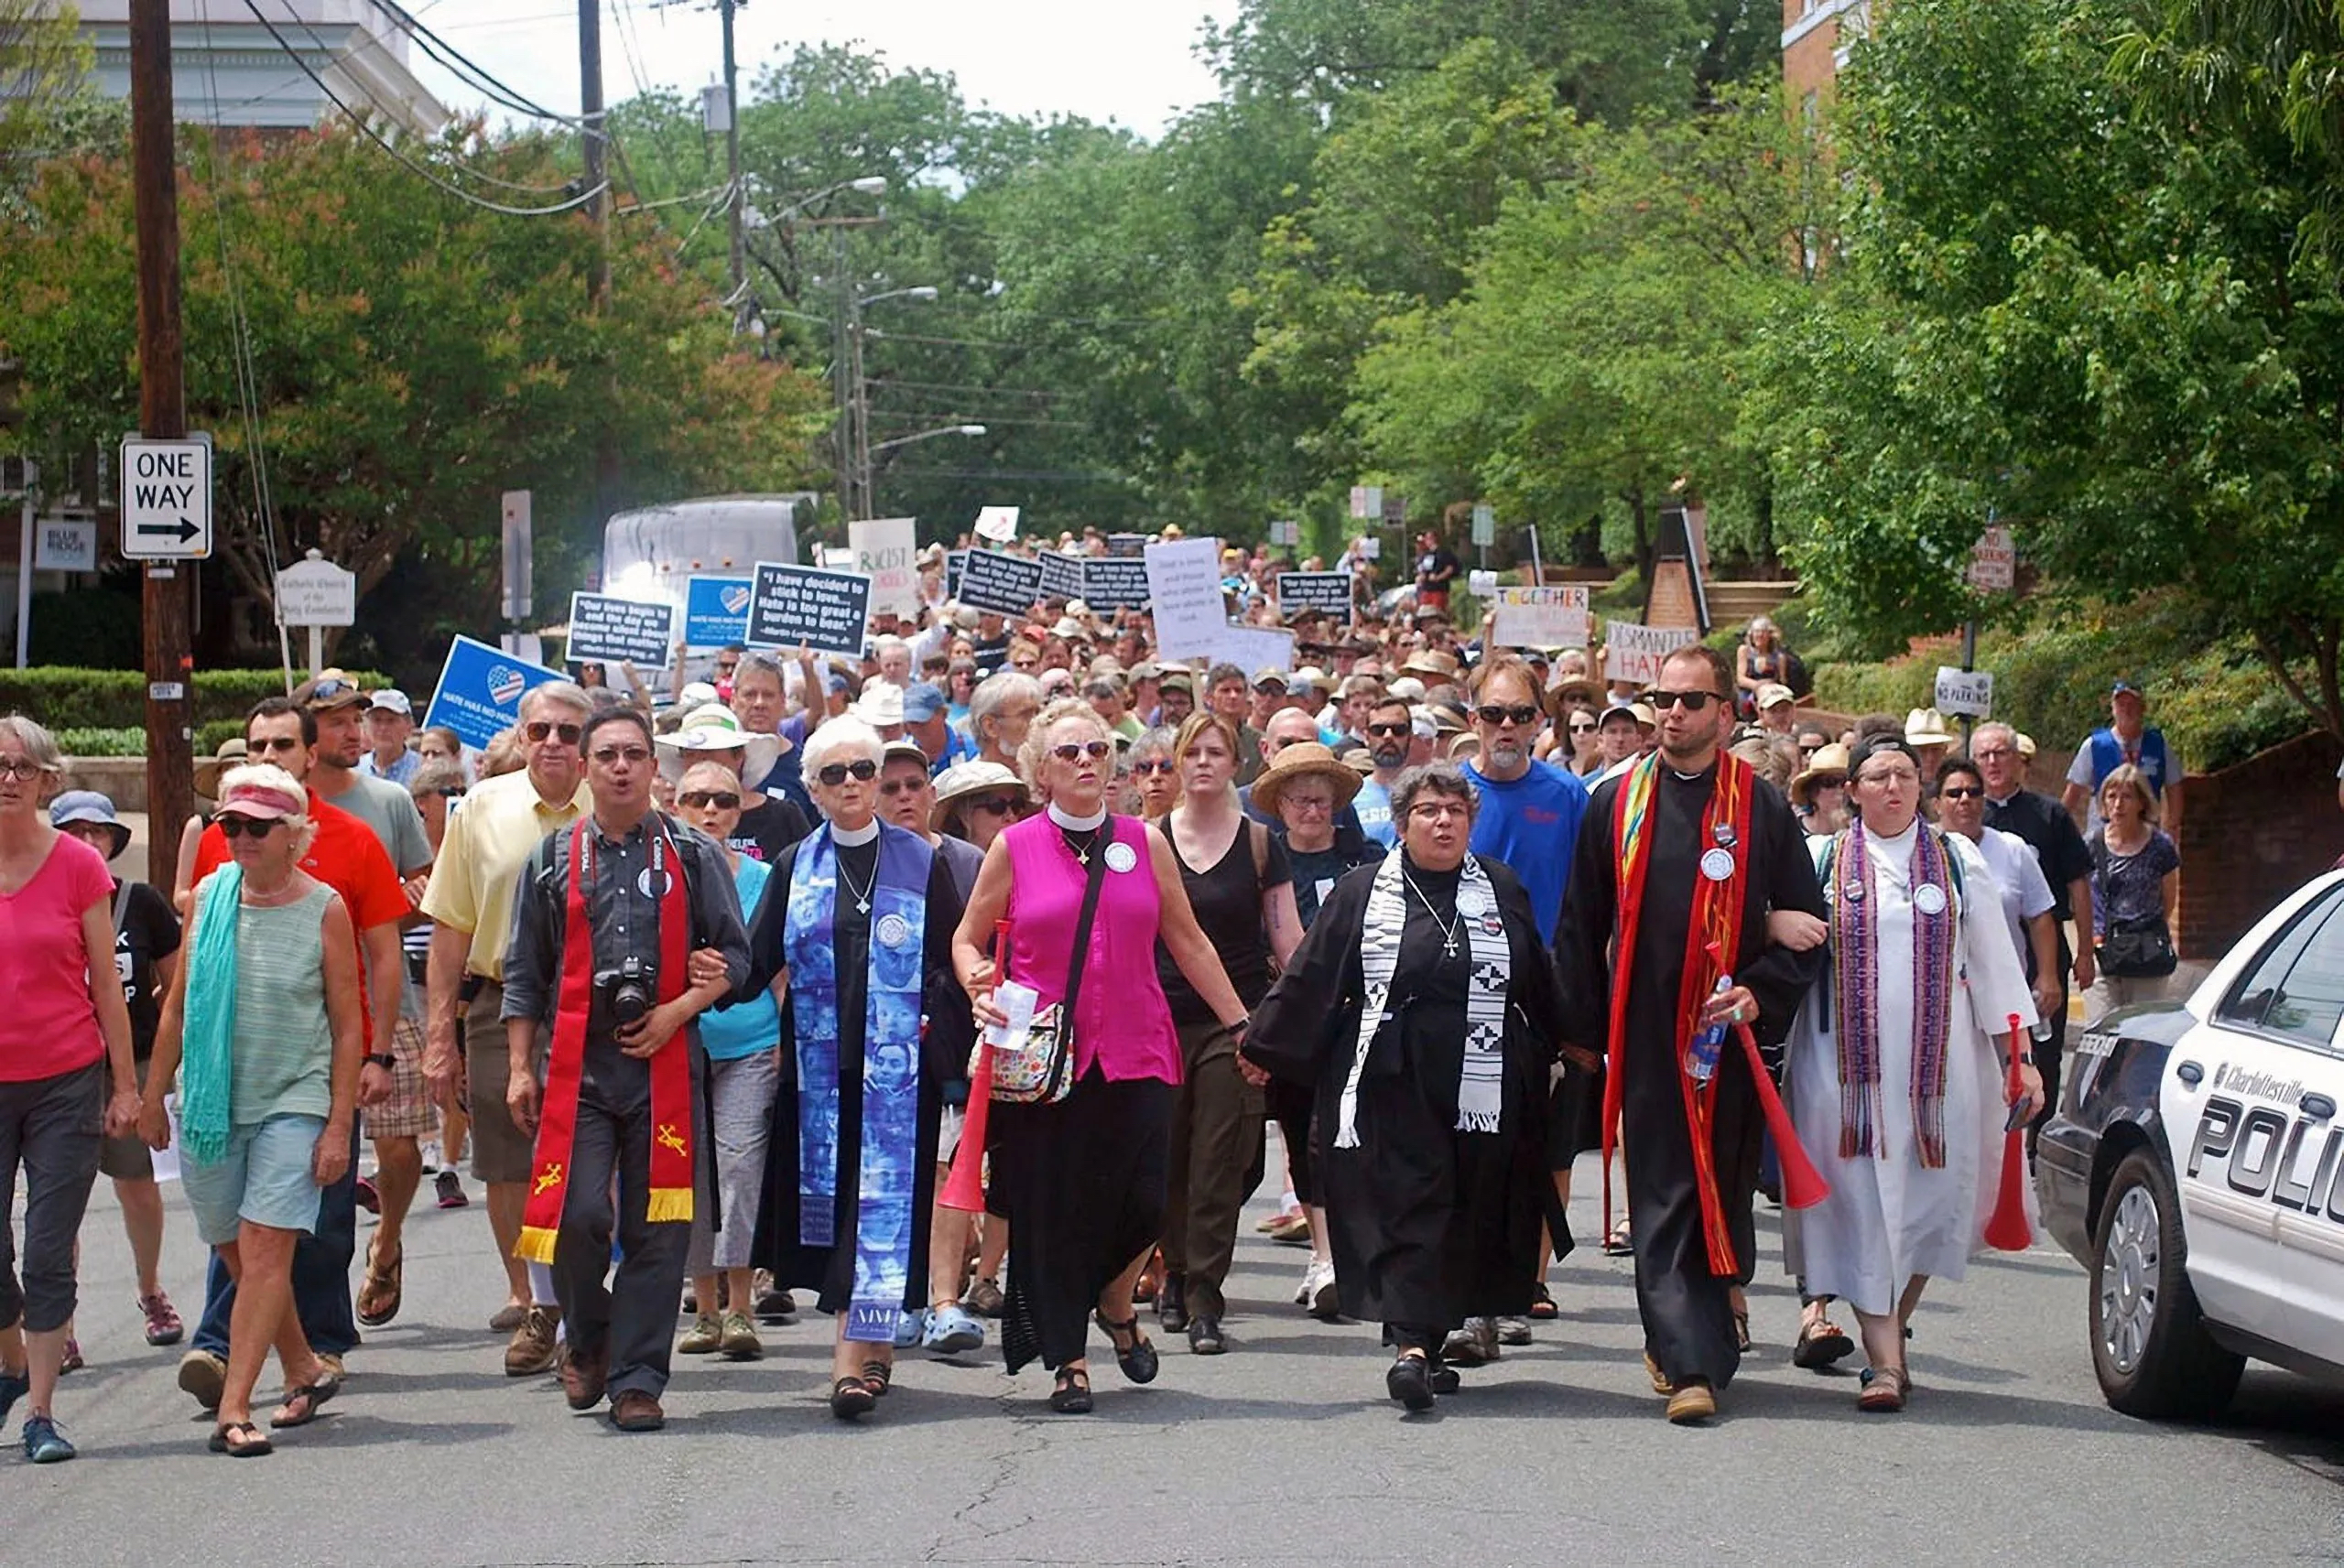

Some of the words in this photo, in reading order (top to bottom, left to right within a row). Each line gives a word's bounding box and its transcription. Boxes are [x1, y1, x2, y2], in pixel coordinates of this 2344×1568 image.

[137, 452, 194, 478] ONE
[136, 484, 194, 510] WAY
[771, 586, 798, 600] stick
[801, 589, 814, 600] to
[776, 573, 803, 587] have
[805, 576, 849, 592] decided
[852, 582, 863, 594] to
[1497, 587, 1584, 608] TOGETHER
[758, 596, 785, 611] Hate
[787, 600, 798, 611] is
[799, 601, 819, 614] too
[820, 605, 851, 619] great
[852, 610, 861, 621] a
[762, 610, 803, 624] burden
[805, 614, 817, 627] to
[1619, 652, 1663, 679] HAT
[441, 691, 464, 706] HATE
[1937, 686, 1948, 700] NO
[1949, 687, 1990, 705] PARKING
[2224, 1065, 2306, 1106] Charlottesville
